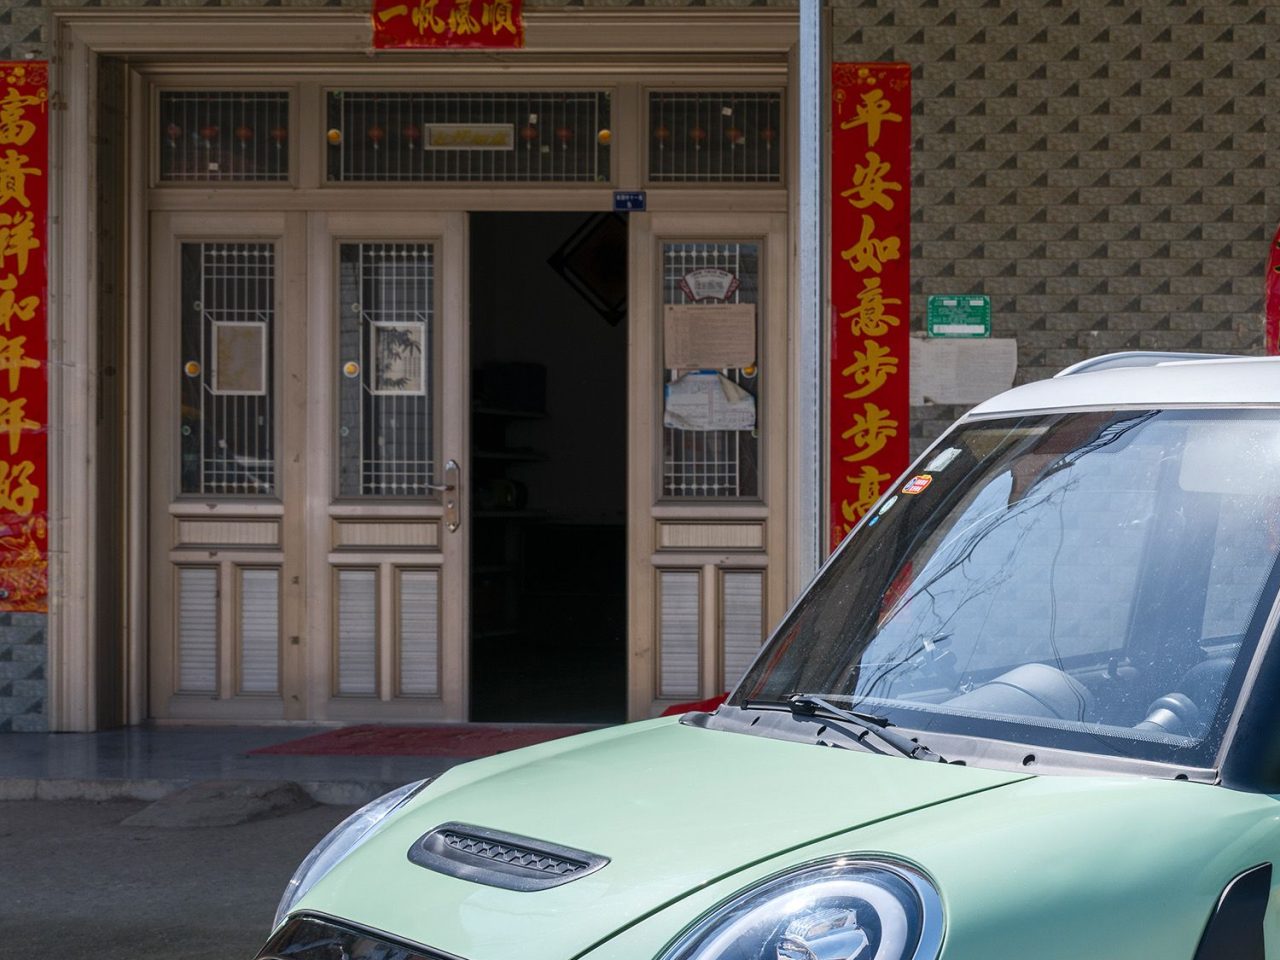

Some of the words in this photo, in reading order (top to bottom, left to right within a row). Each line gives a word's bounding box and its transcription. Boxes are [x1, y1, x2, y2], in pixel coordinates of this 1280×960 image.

[840, 88, 902, 534] 平安如意步步高
